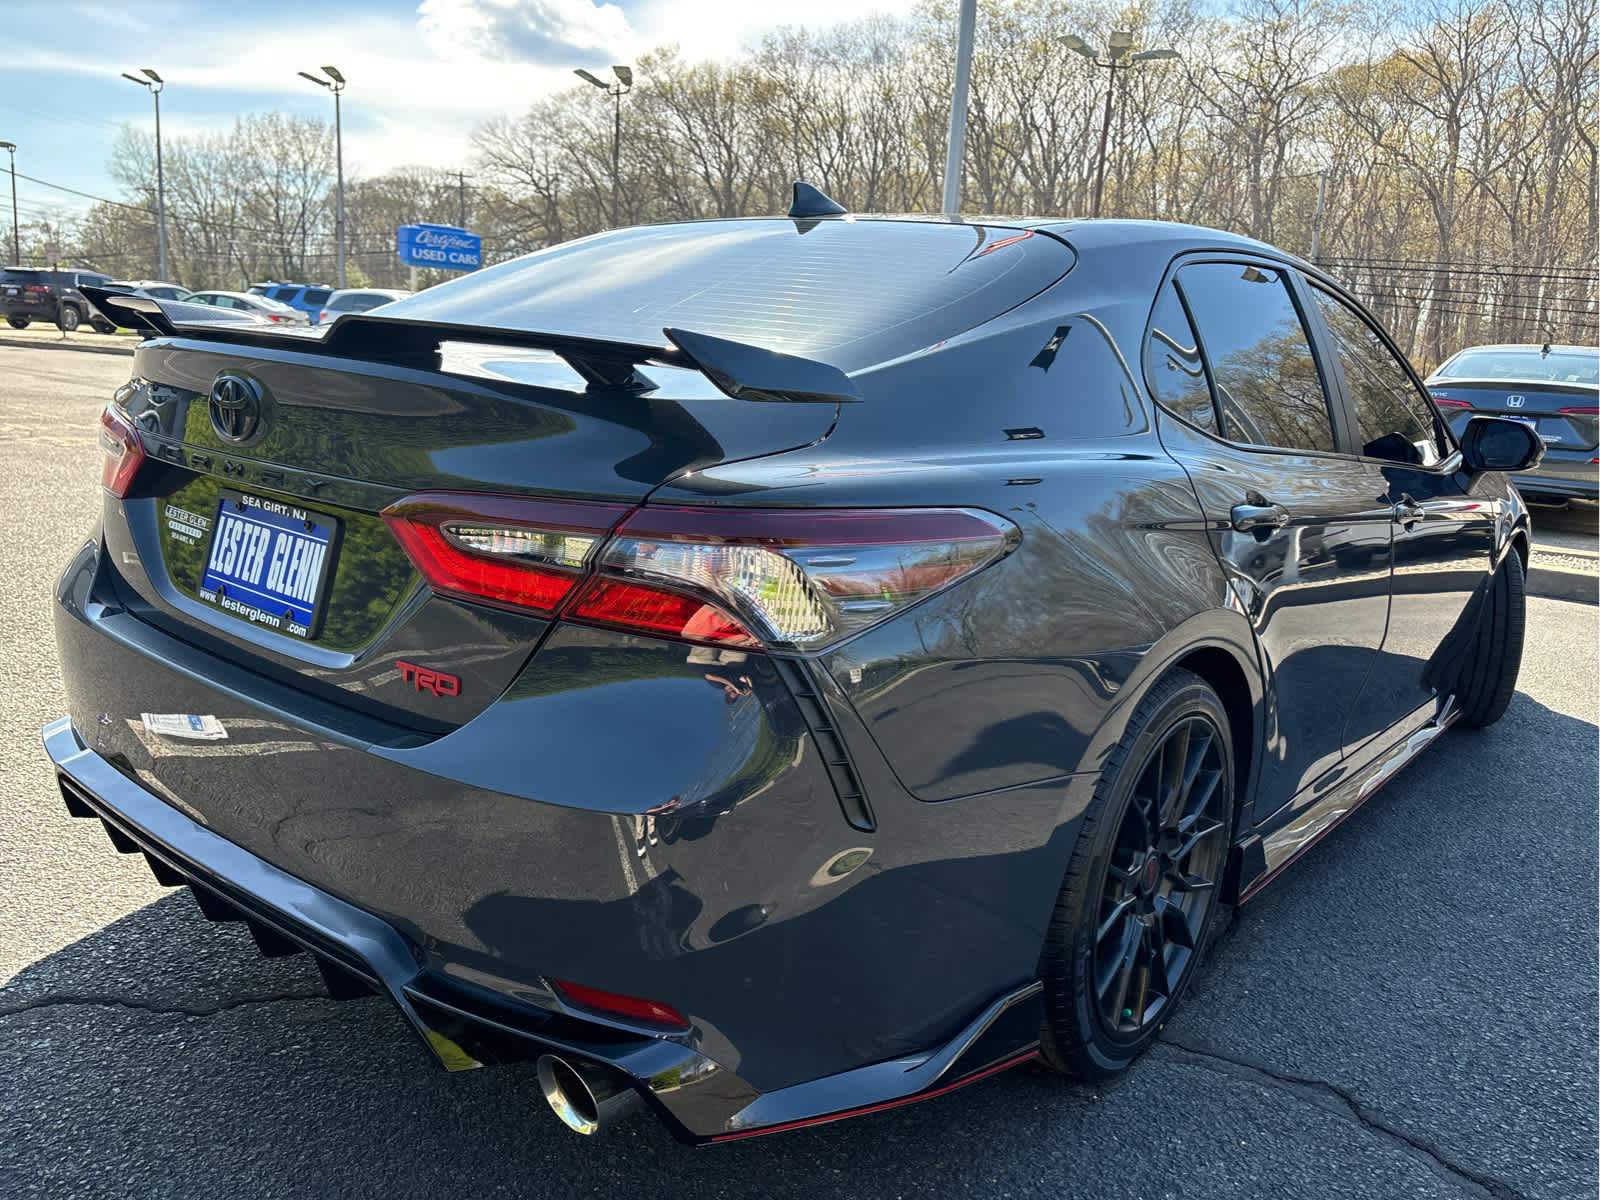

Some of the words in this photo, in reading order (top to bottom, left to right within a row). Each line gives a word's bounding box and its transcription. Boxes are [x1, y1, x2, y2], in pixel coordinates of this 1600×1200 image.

[412, 247, 447, 262] USED
[449, 252, 478, 265] CARS
[166, 506, 188, 521] LESTER
[242, 495, 262, 509] SEA
[263, 501, 290, 517] GIRT,
[293, 509, 307, 521] NJ
[209, 515, 271, 585] LESTER
[266, 532, 327, 604] GLENN
[395, 660, 461, 697] TRD
